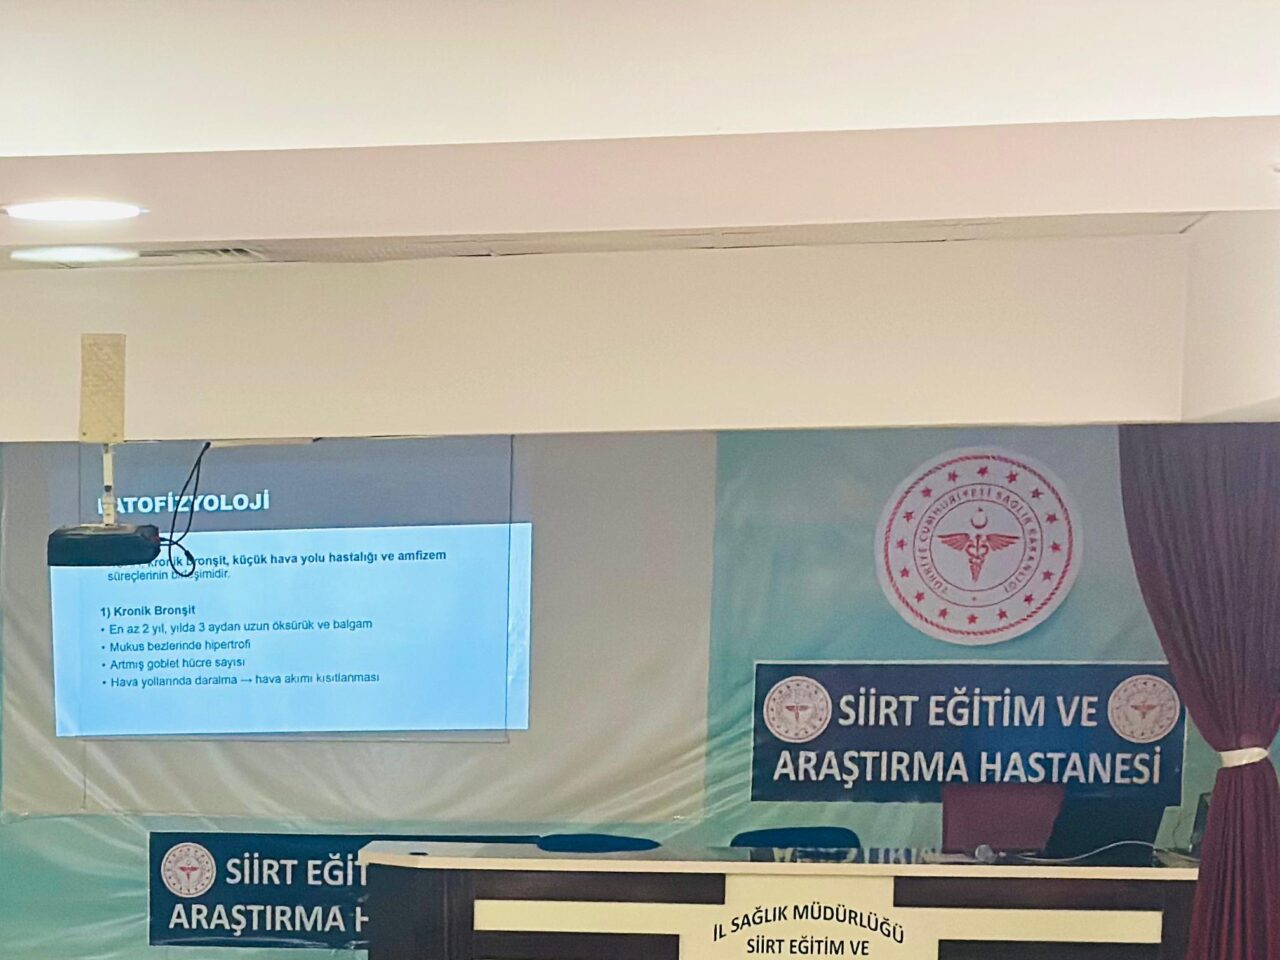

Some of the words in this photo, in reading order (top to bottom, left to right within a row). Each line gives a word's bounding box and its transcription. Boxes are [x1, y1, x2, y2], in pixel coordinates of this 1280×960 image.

[233, 554, 269, 567] küçük
[271, 553, 298, 564] hava
[300, 552, 325, 566] yolu
[329, 551, 378, 564] hastalığı
[381, 552, 394, 561] ve
[398, 550, 447, 561] amfizem
[100, 607, 111, 619] 1)
[113, 605, 152, 617] Kronik
[154, 604, 196, 617] Bronşit
[109, 624, 124, 635] En
[127, 625, 140, 634] az
[142, 623, 150, 634] 2
[170, 622, 196, 635] yılda
[199, 622, 206, 632] 3
[208, 622, 241, 634] aydan
[243, 621, 270, 631] uzun
[272, 619, 314, 631] öksürük
[317, 620, 330, 629] ve
[333, 619, 373, 632] balgam
[110, 641, 145, 652] Mukus
[147, 658, 180, 671] goblet
[182, 657, 212, 668] hücre
[111, 677, 138, 687] Hava
[194, 675, 238, 685] daralma
[255, 674, 281, 684] hava
[838, 686, 919, 726] SİİRT
[928, 685, 1045, 727] EĞİTİM
[1056, 695, 1099, 727] VE
[773, 750, 969, 789] ARAŞTIRMA
[979, 746, 1161, 784] HASTANESİ
[225, 852, 298, 885] SİİRT
[169, 903, 346, 936] ARAŞTIRMA
[731, 905, 788, 933] SAĞLIK
[793, 901, 904, 944] MÜDÜRLÜĞÜ
[746, 935, 785, 954] SİİRT
[789, 935, 844, 955] EĞİTİM
[849, 940, 870, 956] VE
